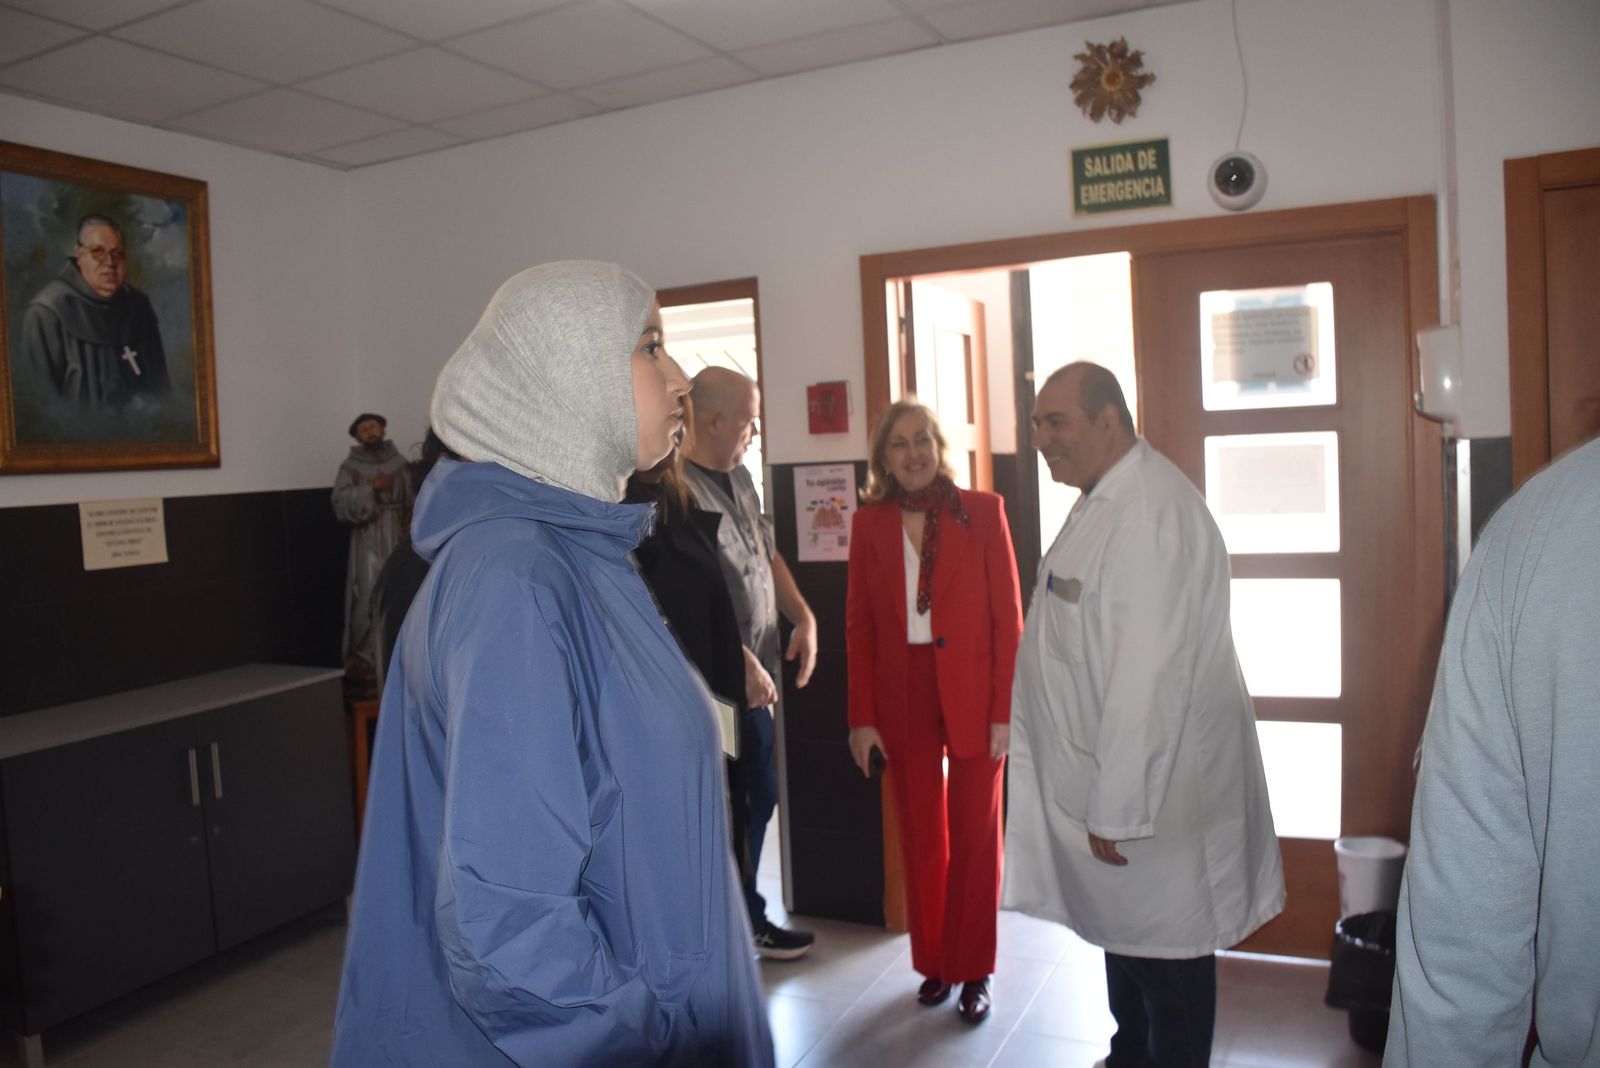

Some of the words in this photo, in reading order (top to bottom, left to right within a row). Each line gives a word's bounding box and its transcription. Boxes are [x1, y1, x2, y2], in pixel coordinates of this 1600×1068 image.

[1084, 152, 1135, 178] SALIDA
[1137, 148, 1157, 171] DE
[1081, 176, 1165, 205] EMERGENCIA
